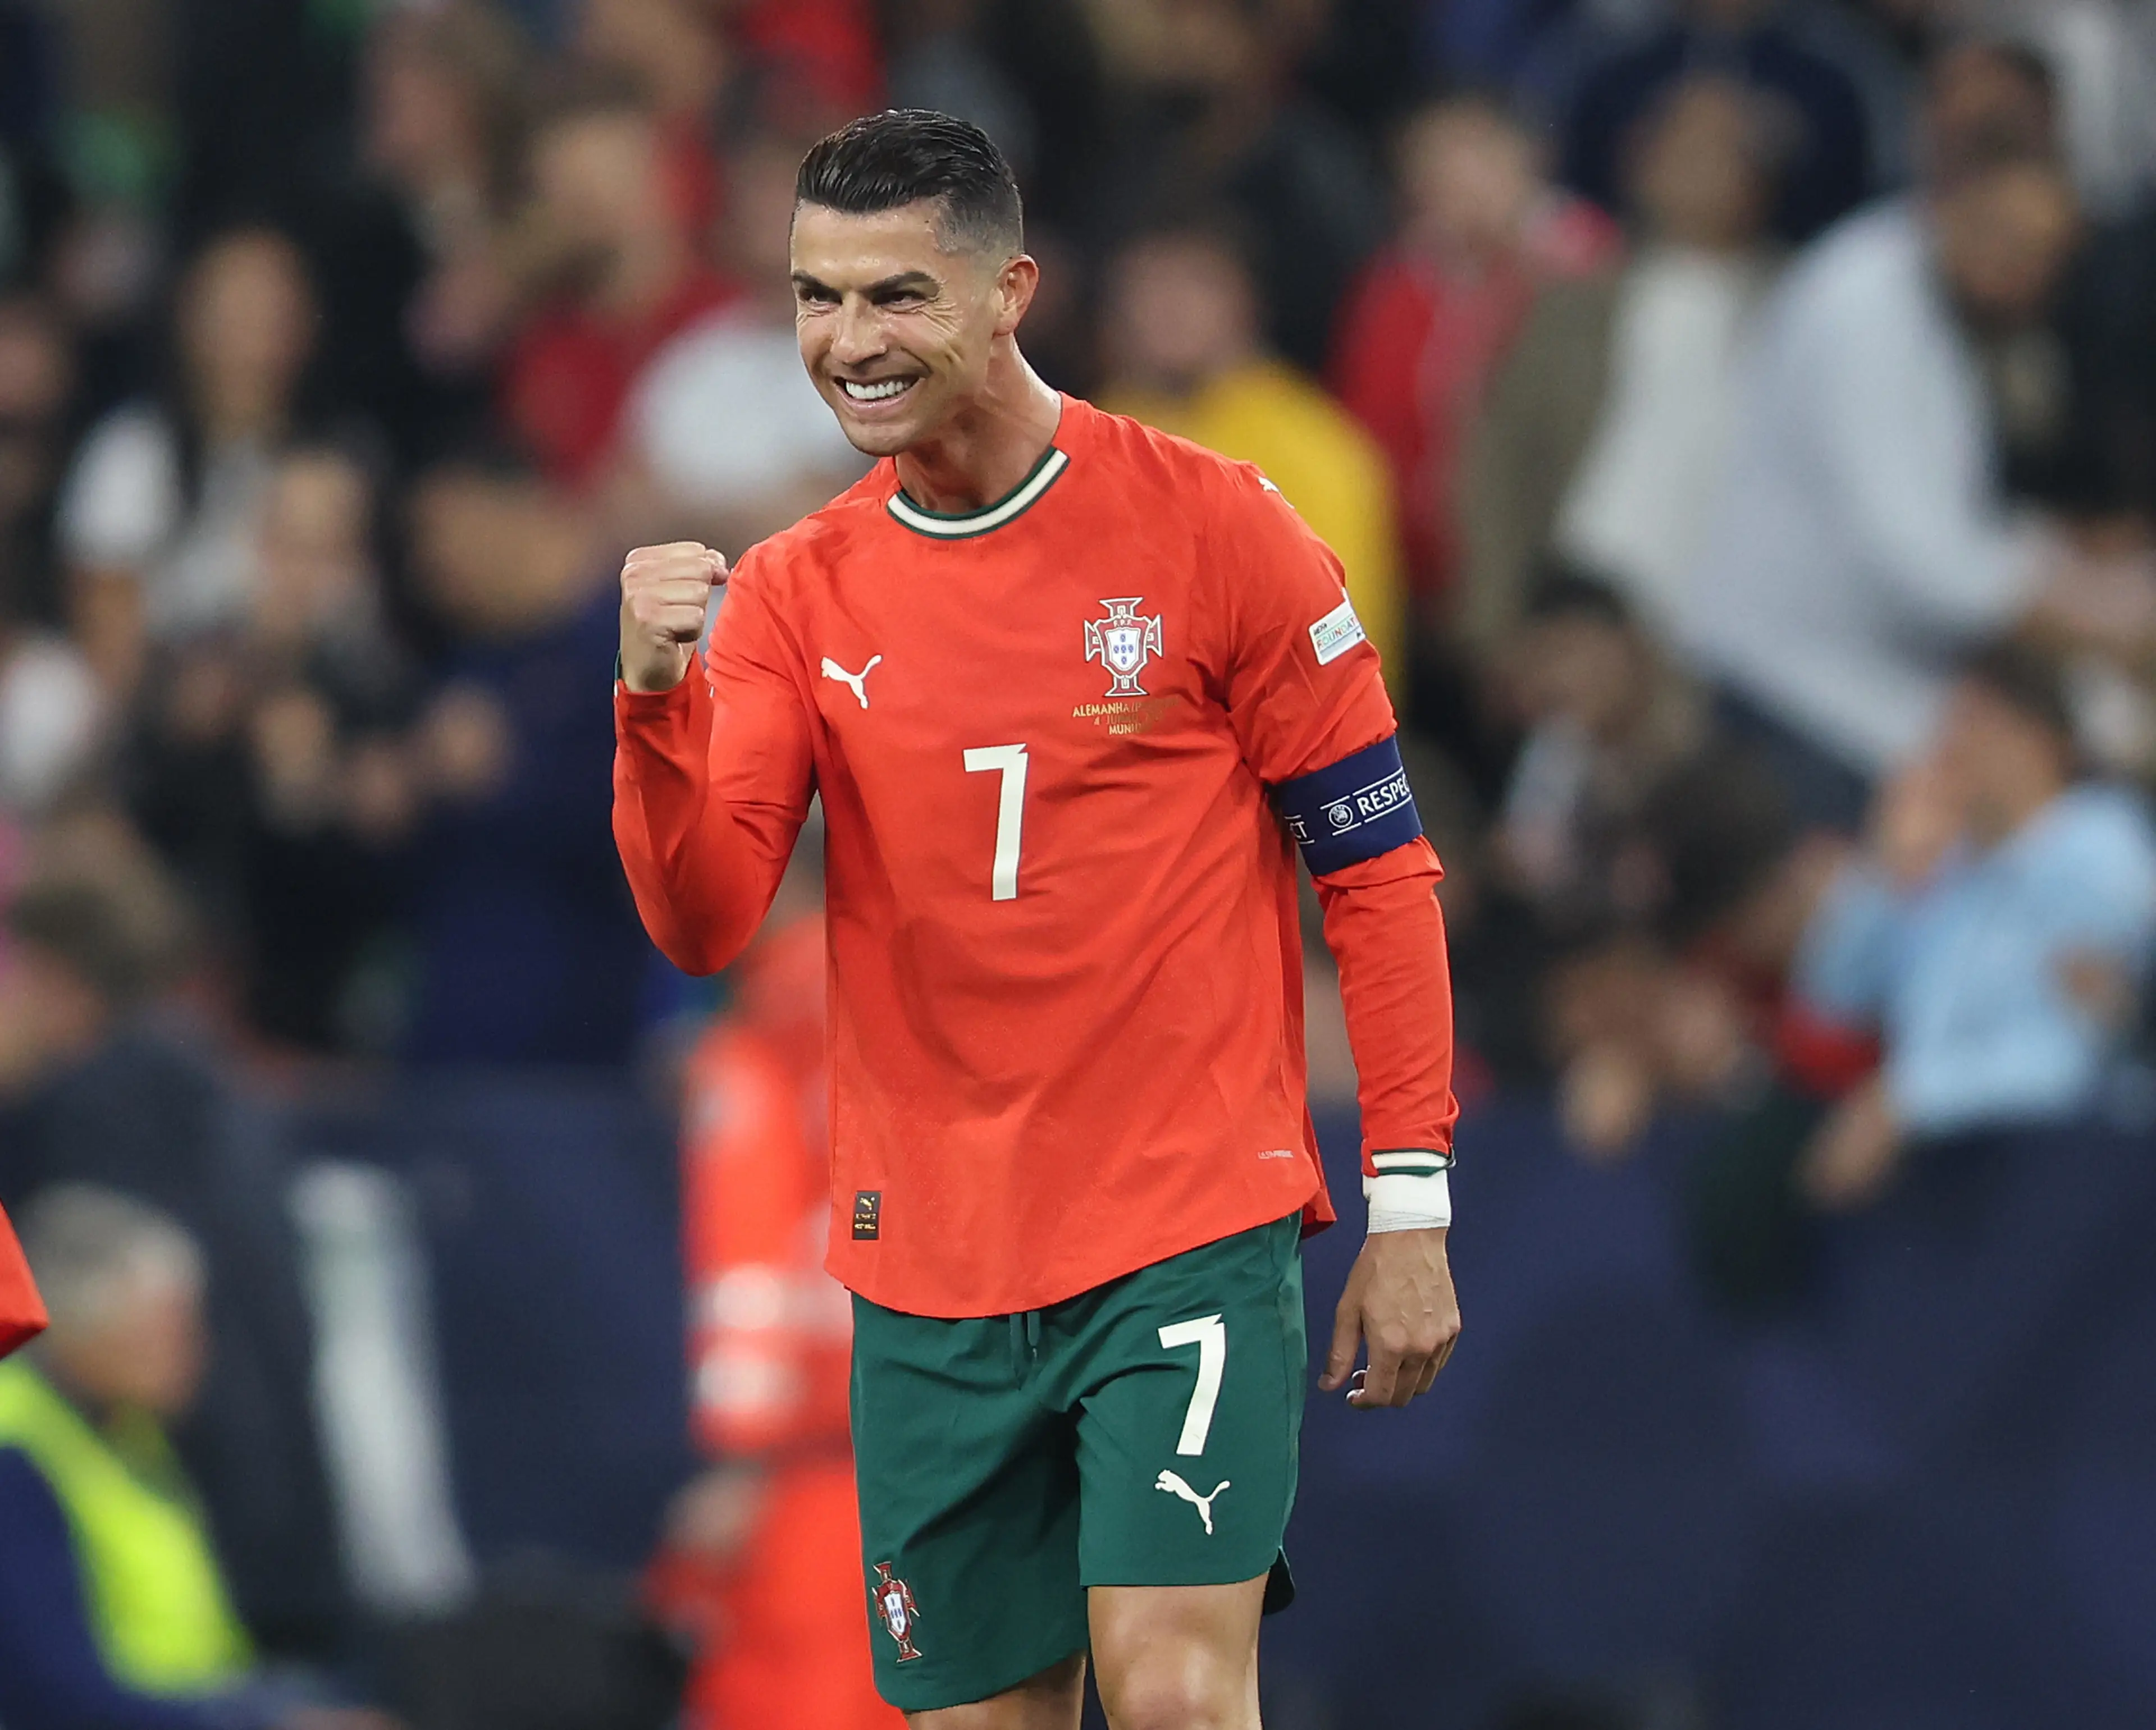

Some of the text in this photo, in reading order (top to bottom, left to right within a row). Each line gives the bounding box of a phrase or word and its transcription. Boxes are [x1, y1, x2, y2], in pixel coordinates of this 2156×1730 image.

[1072, 702, 1129, 718] ALEMANHA
[963, 743, 1029, 901] 7
[1158, 1313, 1226, 1456] 7
